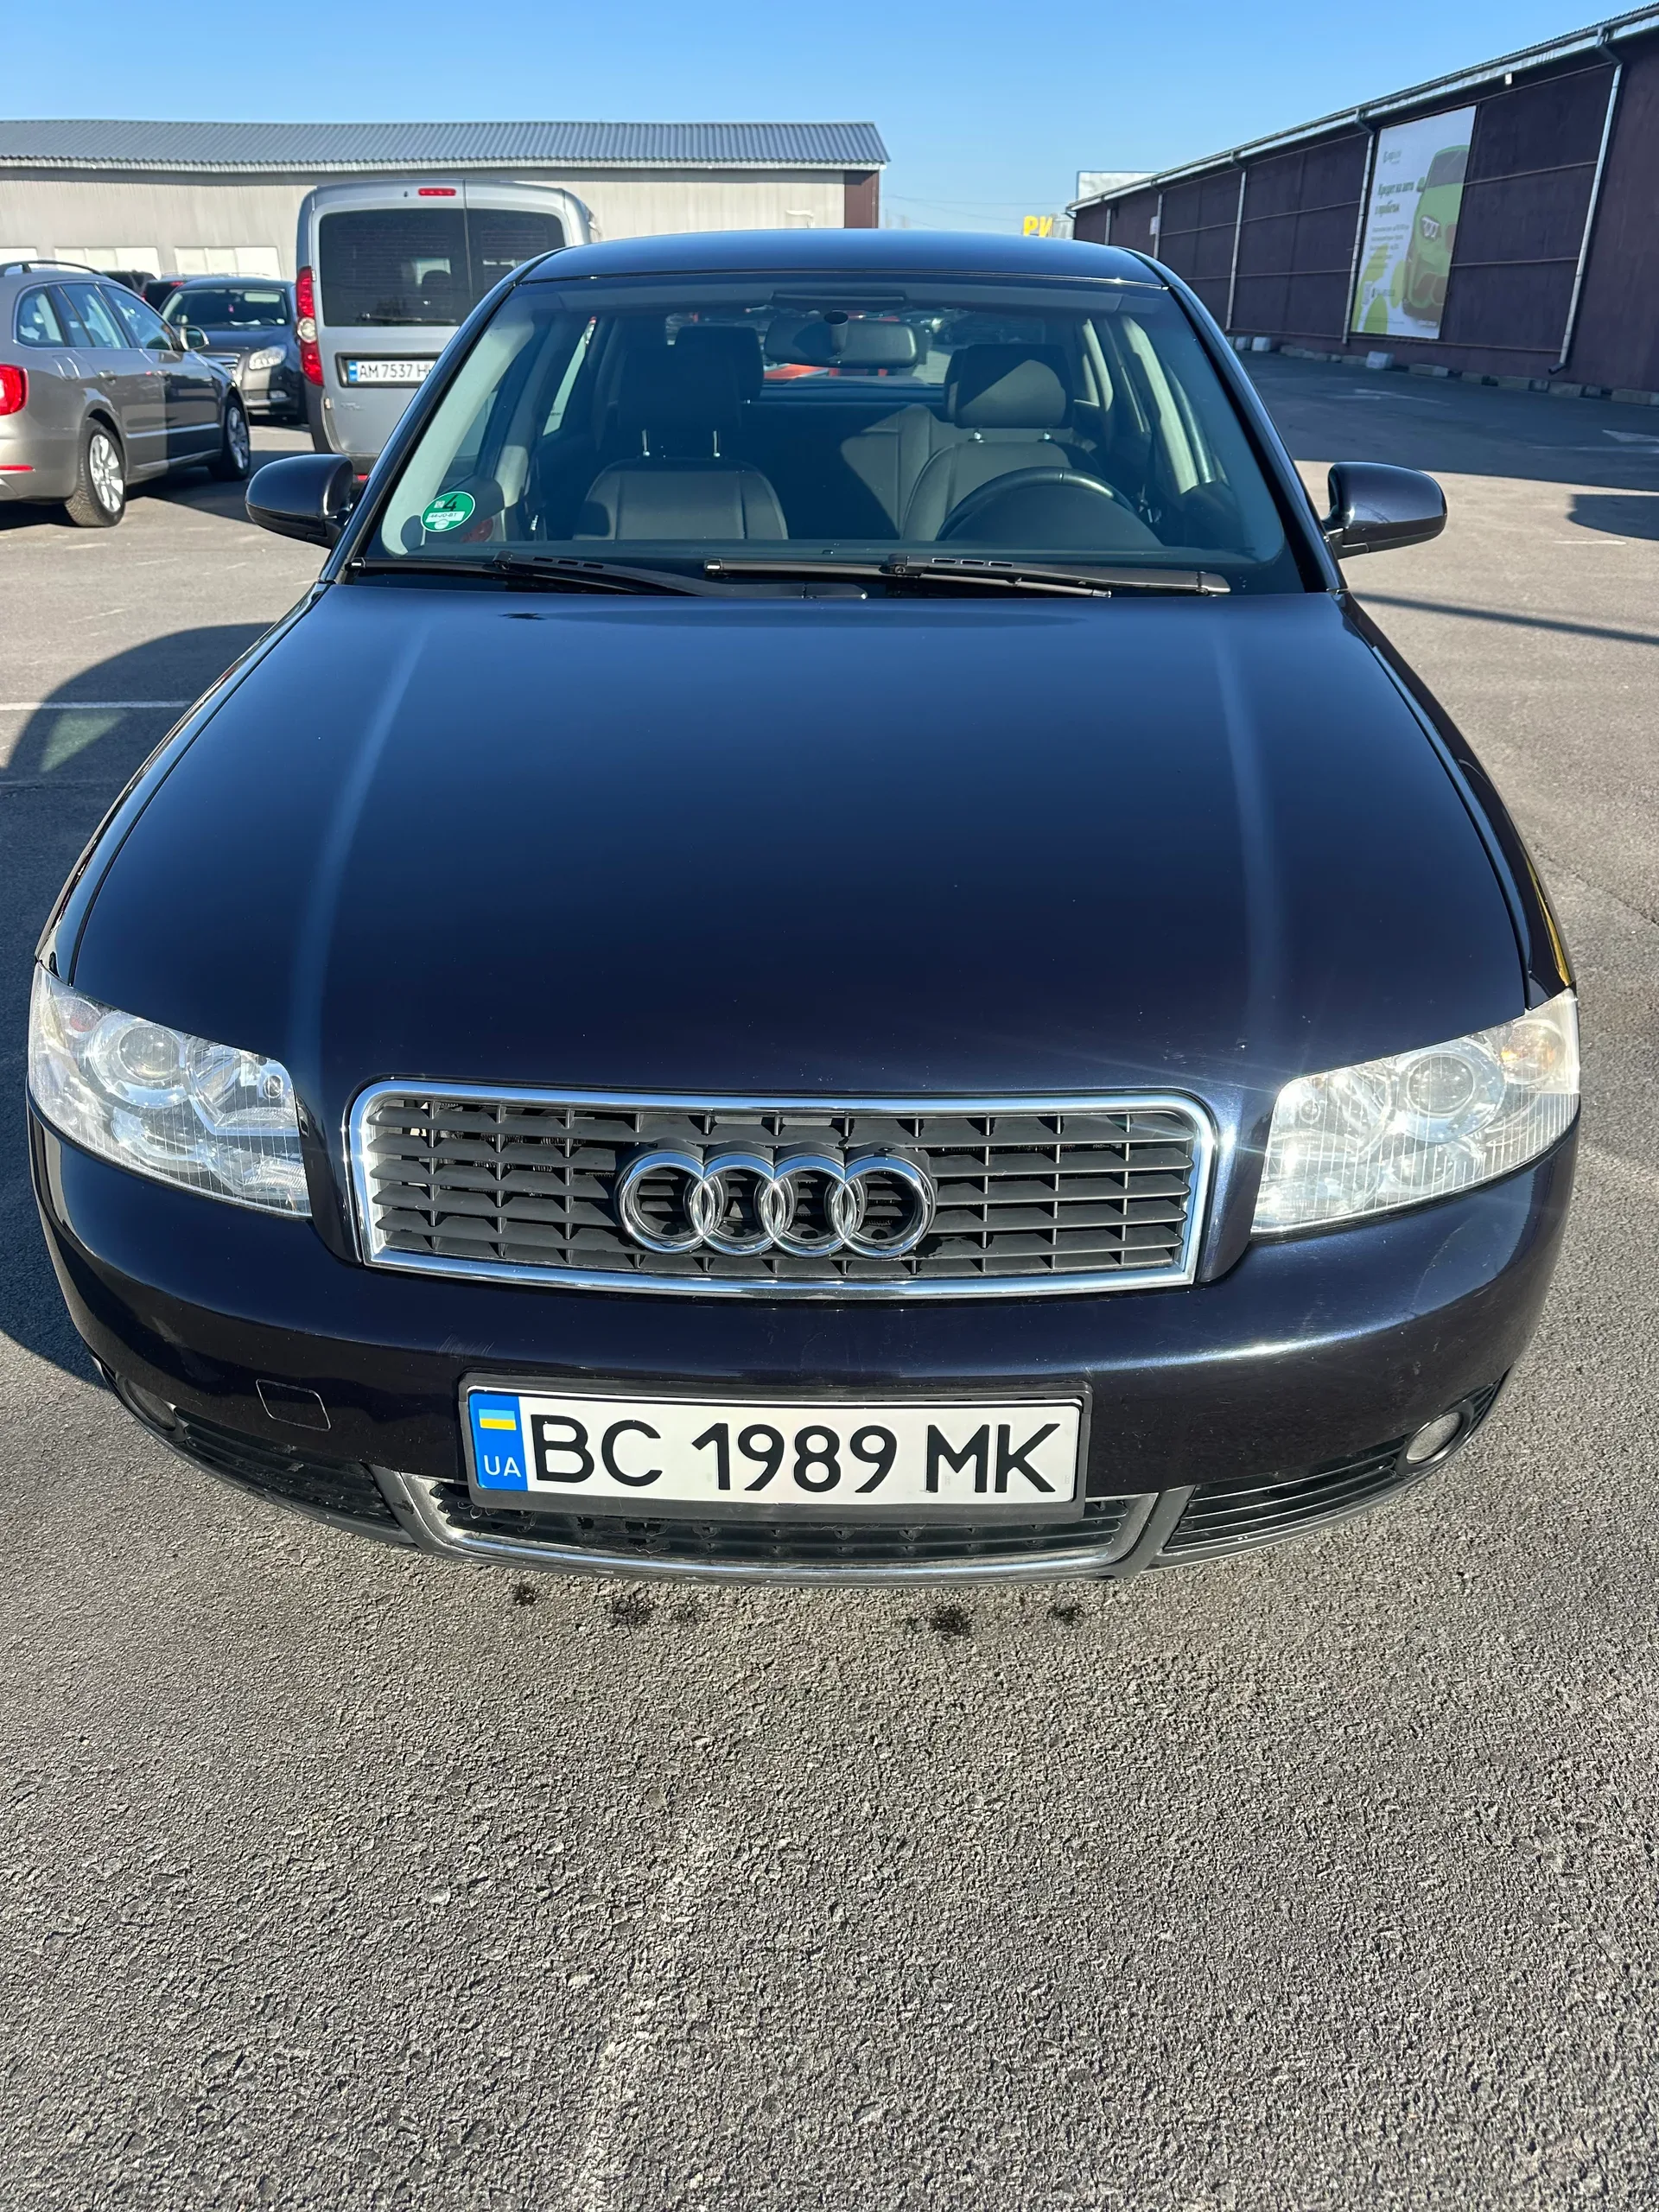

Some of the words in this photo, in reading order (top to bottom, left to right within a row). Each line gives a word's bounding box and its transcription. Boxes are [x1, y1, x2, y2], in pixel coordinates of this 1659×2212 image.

[359, 364, 379, 378] AM
[381, 364, 413, 378] 7537
[416, 363, 432, 378] H
[442, 494, 459, 511] 4
[531, 1414, 663, 1487] BC
[692, 1423, 898, 1493] 1989
[925, 1423, 1060, 1493] MK
[484, 1456, 521, 1478] UA
